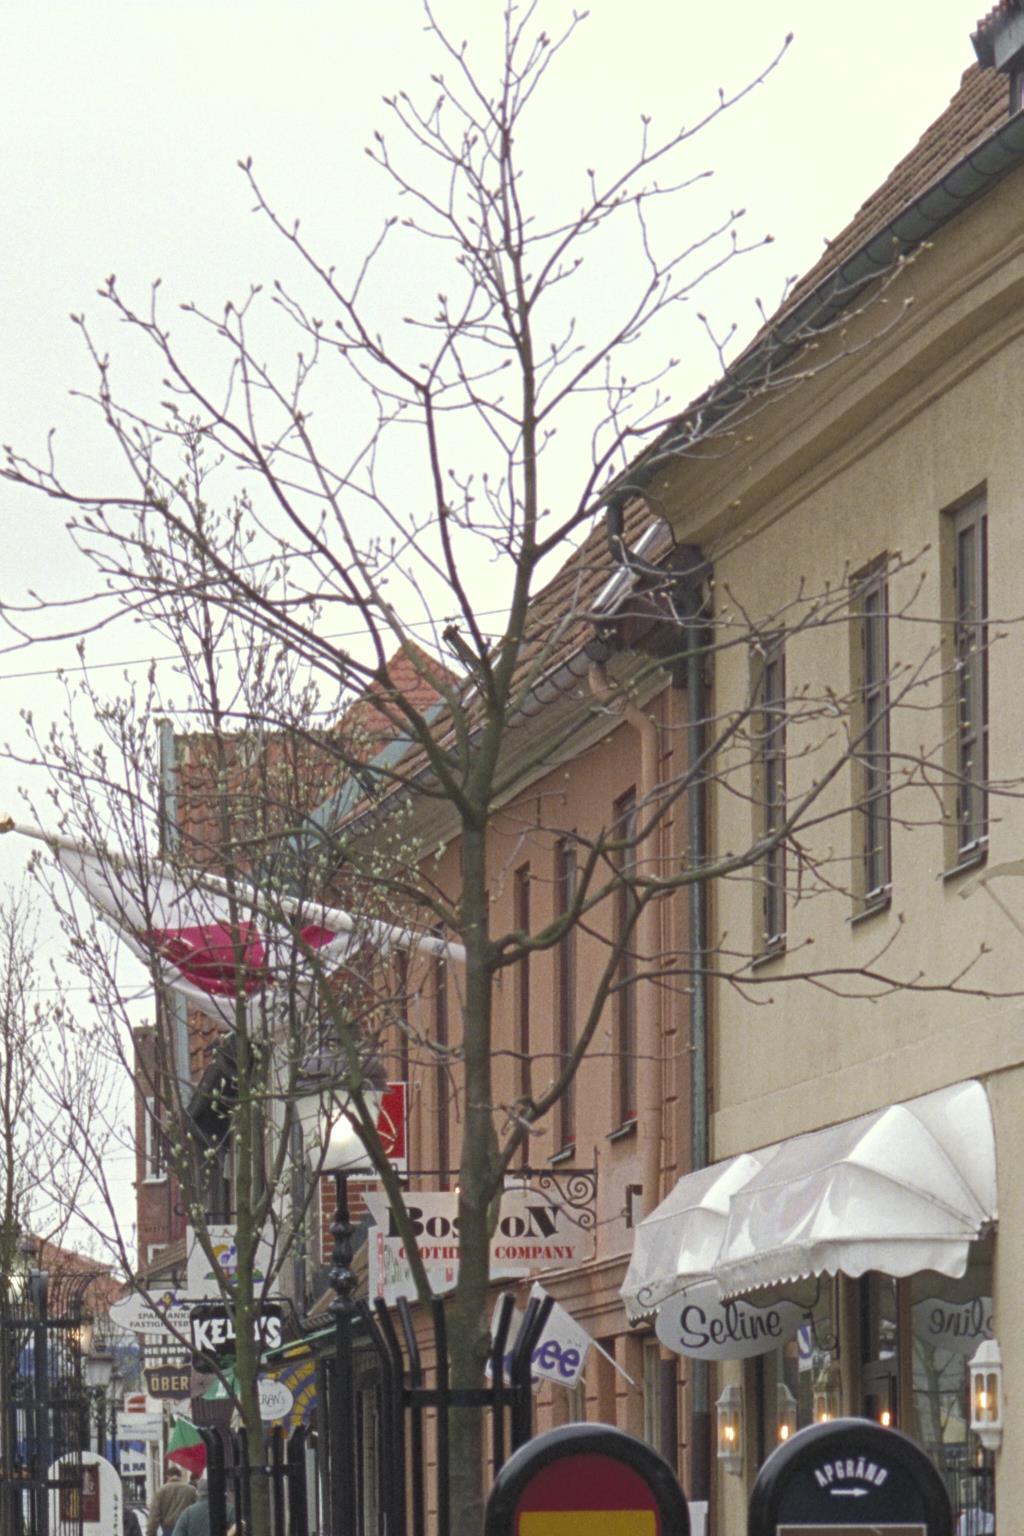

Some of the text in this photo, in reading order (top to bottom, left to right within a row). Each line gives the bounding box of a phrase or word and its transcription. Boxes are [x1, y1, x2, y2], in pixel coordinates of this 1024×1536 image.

[495, 1246, 575, 1259] COMPANY
[680, 1300, 783, 1348] Seline
[814, 1456, 888, 1487] APGRÄND
